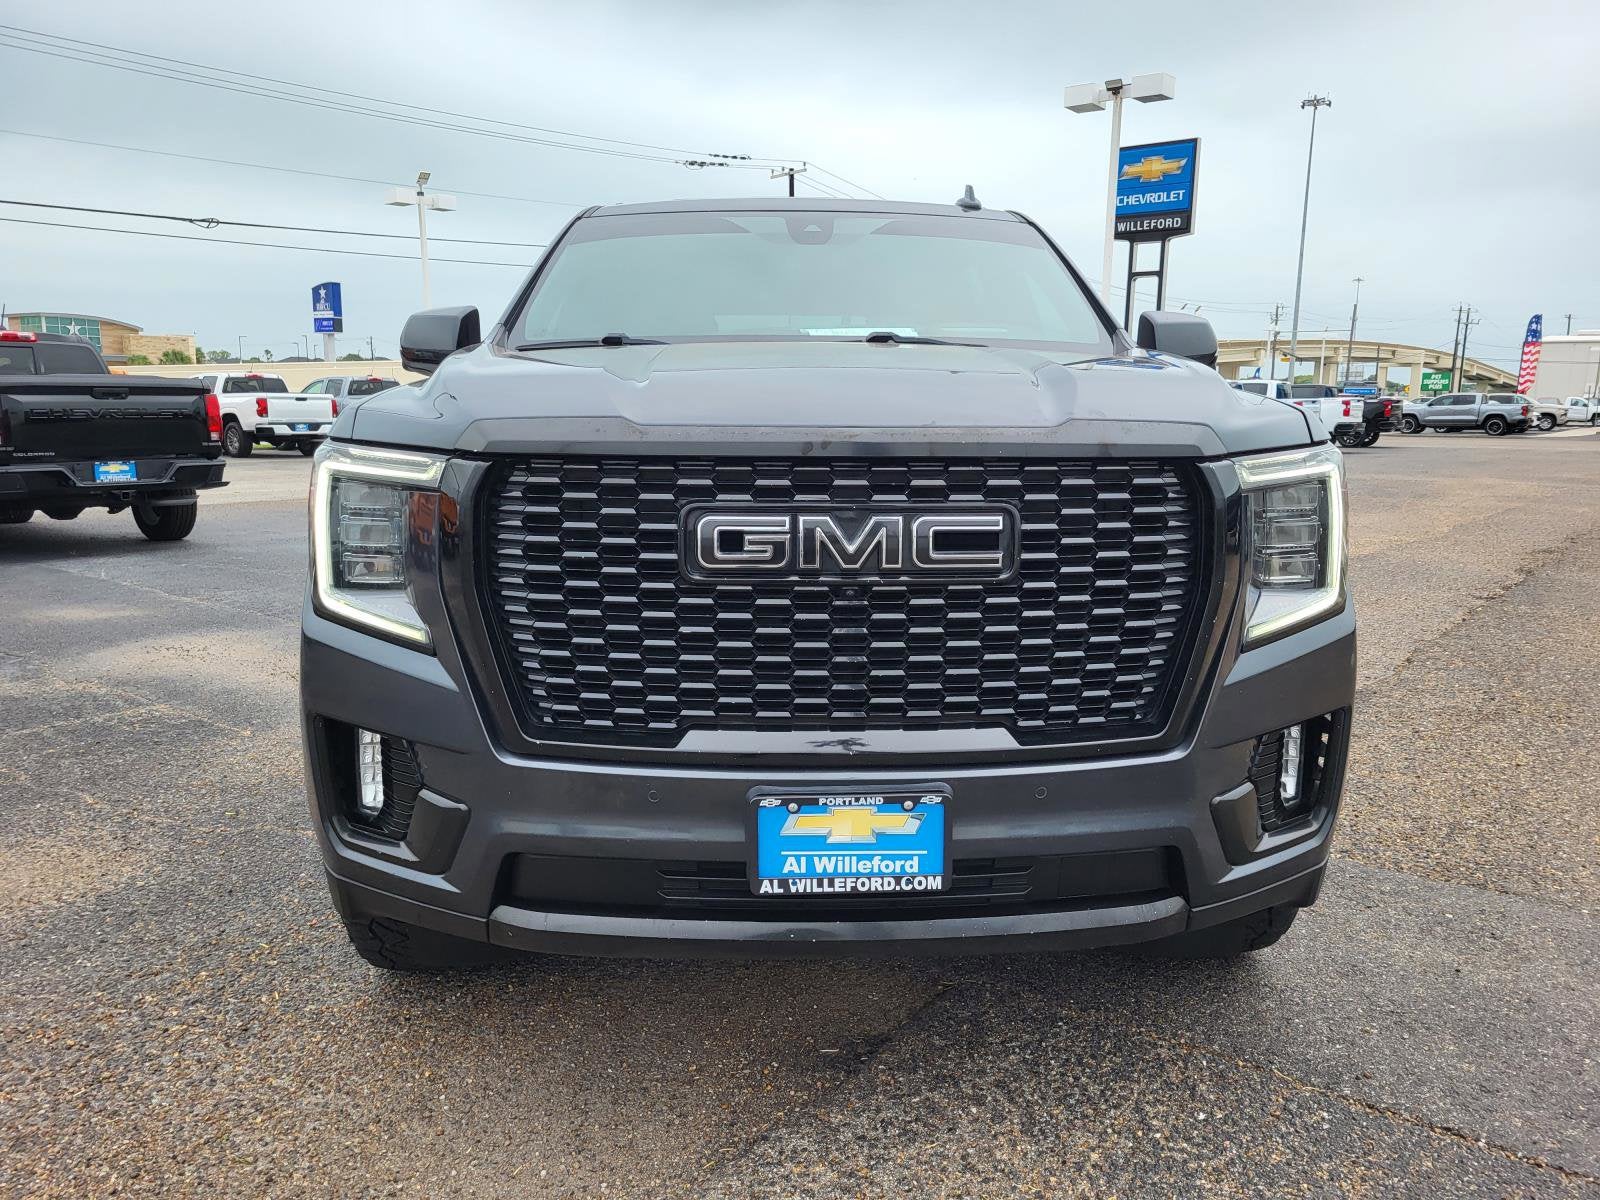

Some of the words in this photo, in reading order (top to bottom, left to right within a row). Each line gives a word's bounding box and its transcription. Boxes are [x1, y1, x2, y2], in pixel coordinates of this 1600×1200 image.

[1117, 189, 1185, 206] CHEVROLET
[1117, 218, 1182, 232] WILLEFORD
[25, 407, 193, 421] CHEVROLET
[697, 514, 1004, 568] GMC
[818, 797, 884, 806] PORTLAND
[782, 857, 806, 874] Al
[814, 856, 919, 874] Willeford
[760, 879, 783, 894] AL
[789, 876, 942, 893] WILLEFORD.COM
